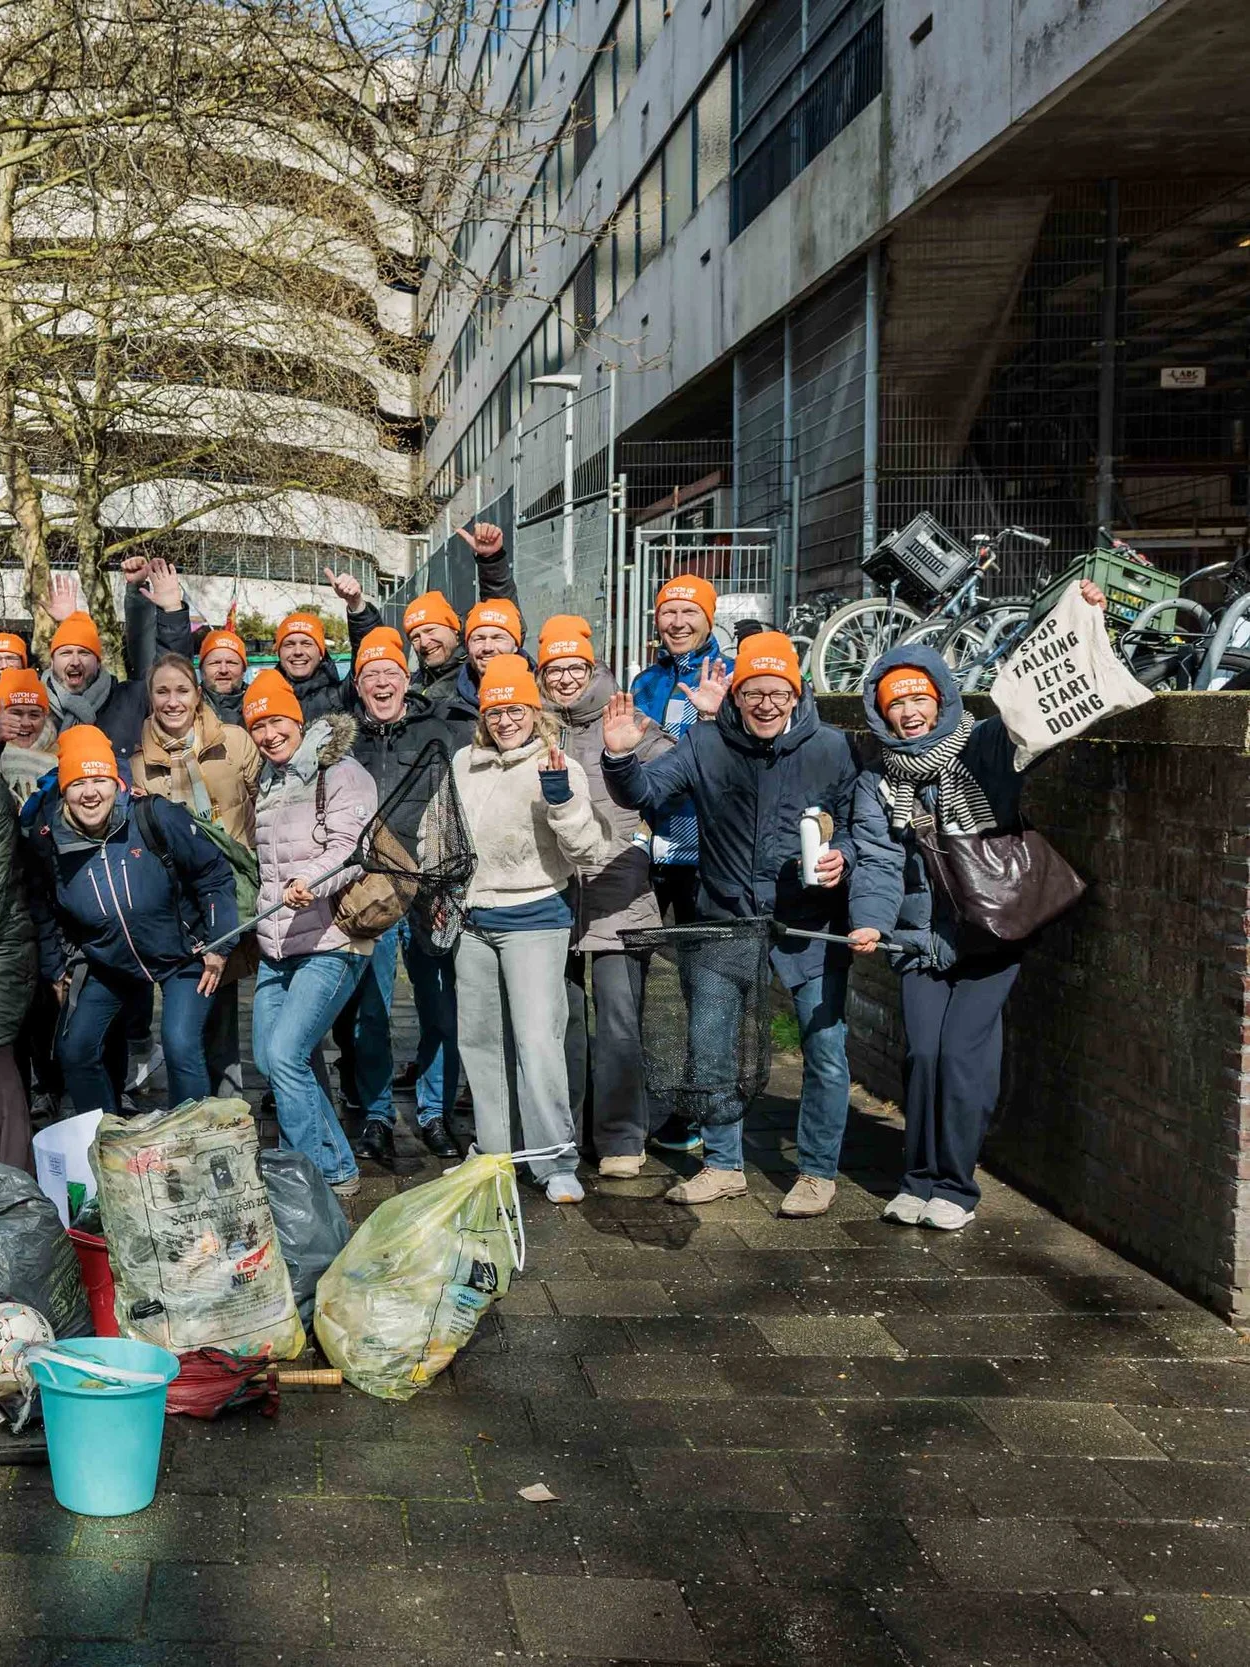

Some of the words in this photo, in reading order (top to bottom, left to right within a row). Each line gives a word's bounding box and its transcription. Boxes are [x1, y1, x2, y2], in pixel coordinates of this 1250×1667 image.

[665, 586, 685, 594] CATCH
[1013, 631, 1079, 679] TALKING
[753, 663, 767, 671] THE
[769, 664, 785, 672] DAY
[1033, 658, 1076, 692] LET'S
[504, 686, 514, 694] OF
[890, 678, 915, 691] CATCH
[893, 687, 910, 695] THE
[911, 684, 928, 692] DAY
[1038, 674, 1091, 714] START
[258, 697, 268, 705] OF
[253, 704, 267, 714] DAY
[1046, 693, 1105, 735] DOING
[81, 760, 104, 769] CATCH
[236, 1195, 255, 1212] één
